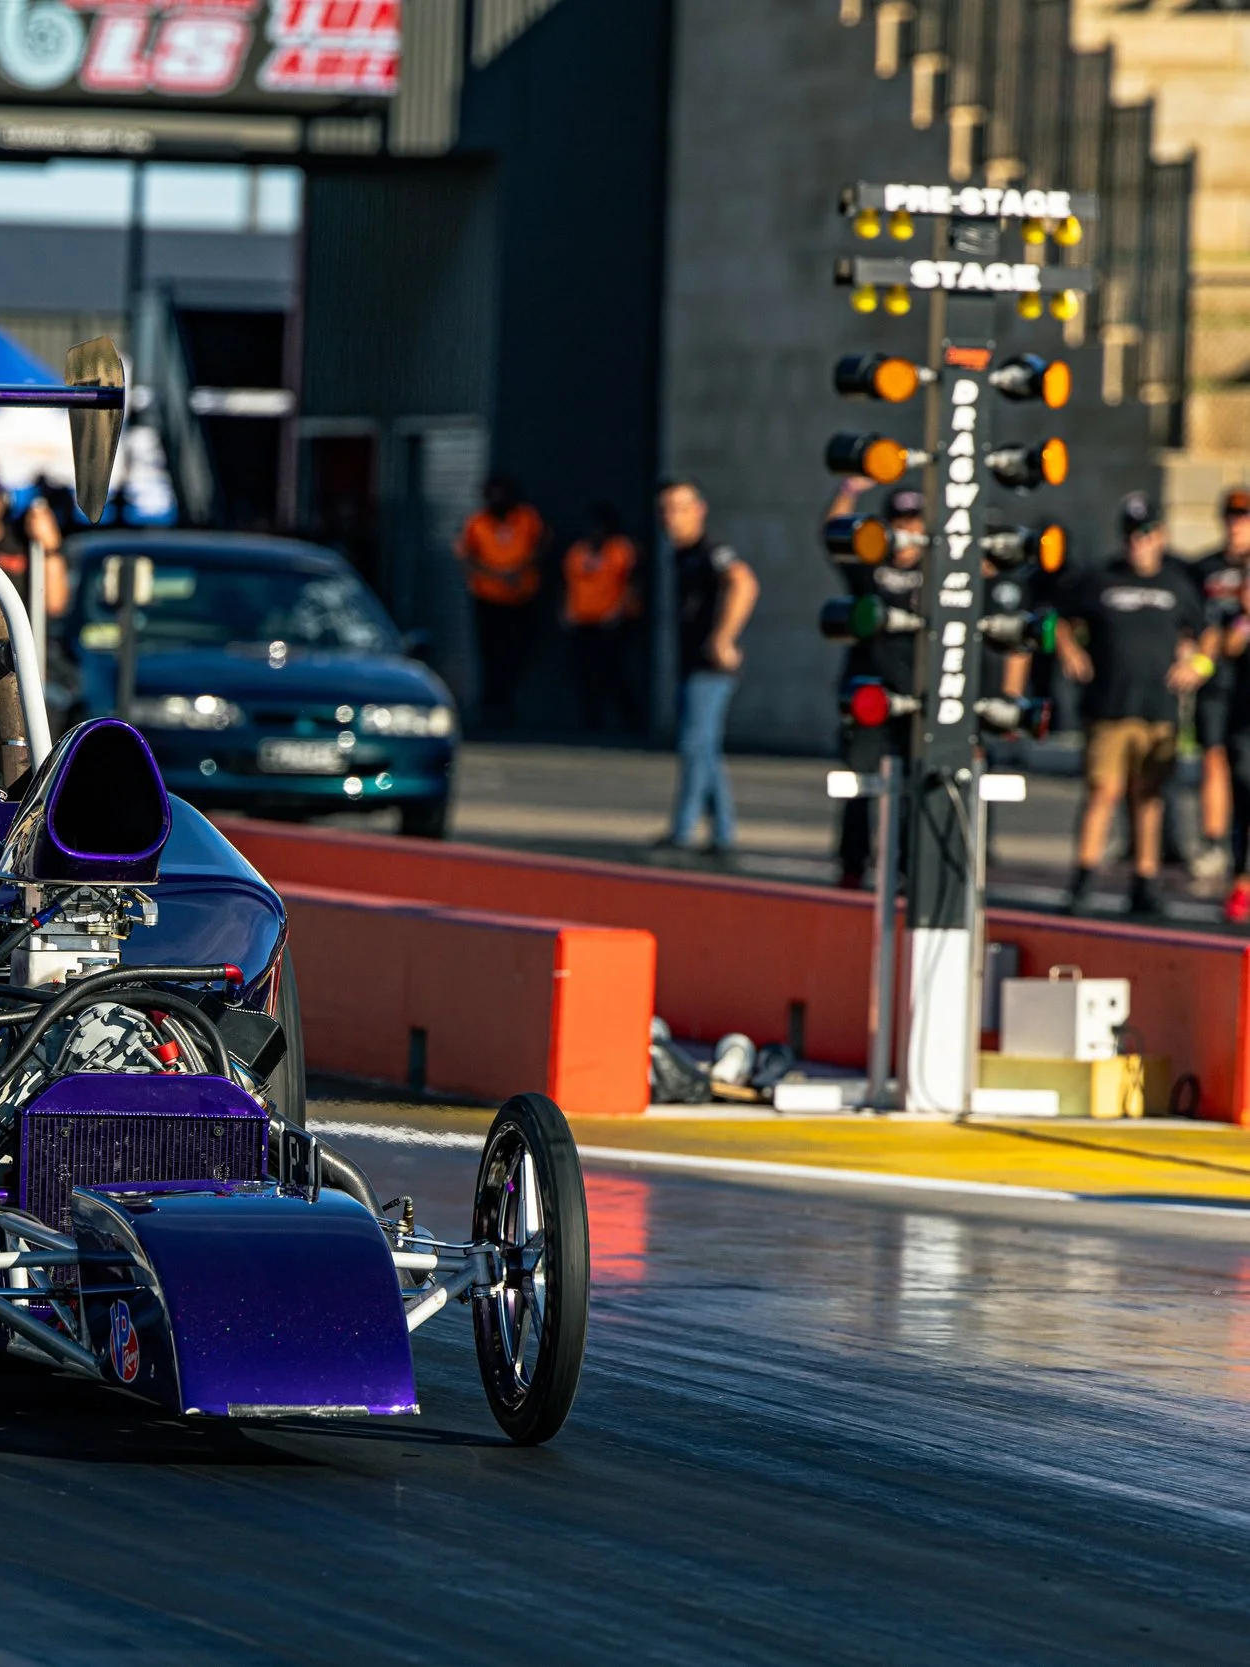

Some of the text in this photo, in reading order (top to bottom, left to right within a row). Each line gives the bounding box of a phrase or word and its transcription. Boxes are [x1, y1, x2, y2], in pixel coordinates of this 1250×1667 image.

[79, 14, 257, 95] LS
[884, 184, 1071, 219] PRE-STAGE
[910, 260, 1041, 292] STAGE
[945, 379, 980, 560] DRAGWAY
[938, 621, 966, 724] BEND
